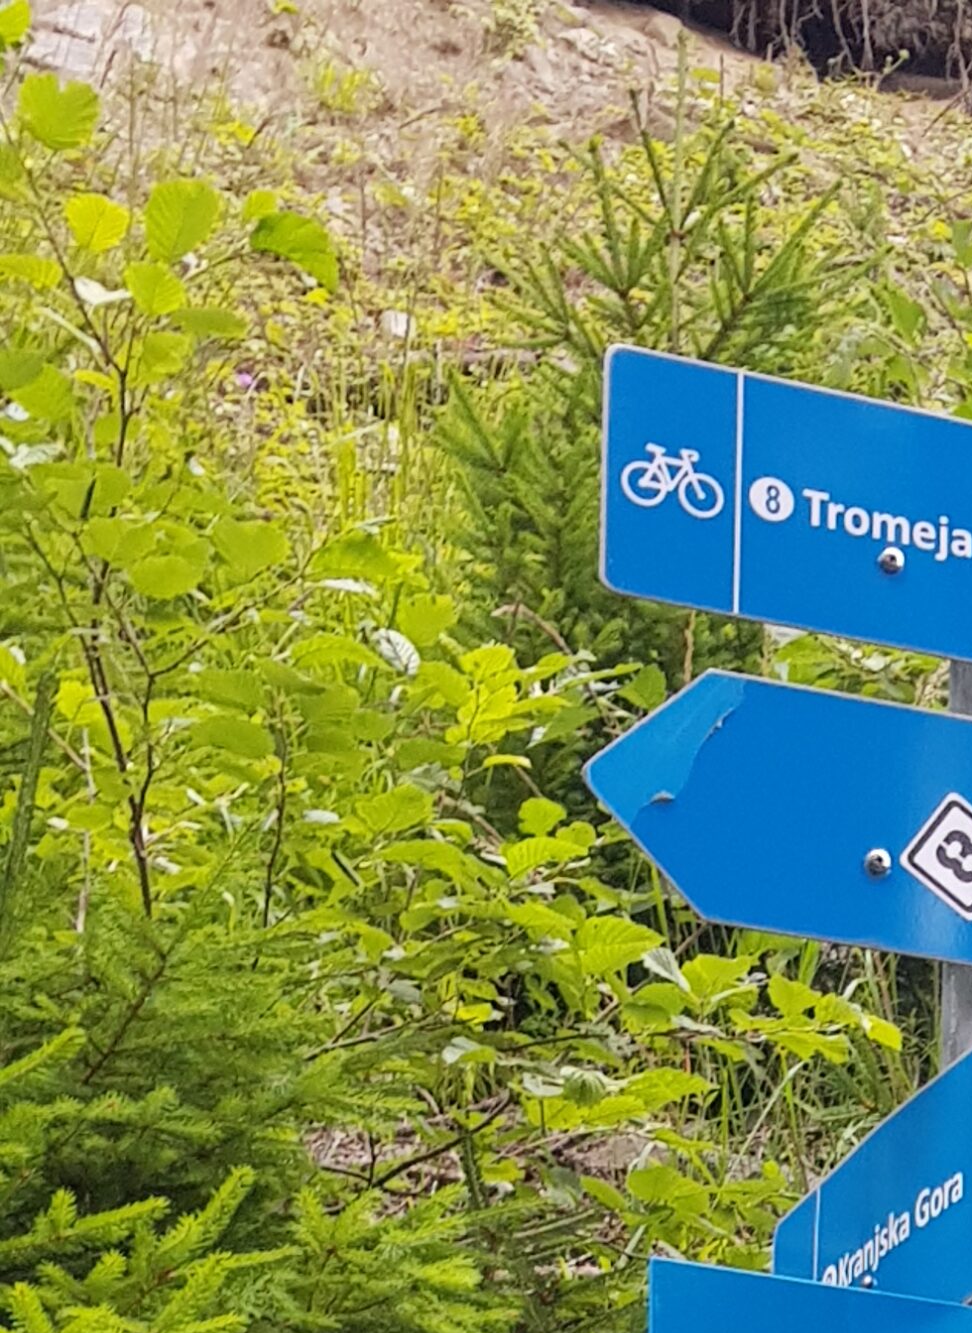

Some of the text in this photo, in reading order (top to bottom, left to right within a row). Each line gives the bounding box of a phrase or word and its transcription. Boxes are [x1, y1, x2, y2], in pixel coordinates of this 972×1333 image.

[803, 489, 972, 560] Tromeja
[838, 1172, 963, 1288] Kranjska Gora
